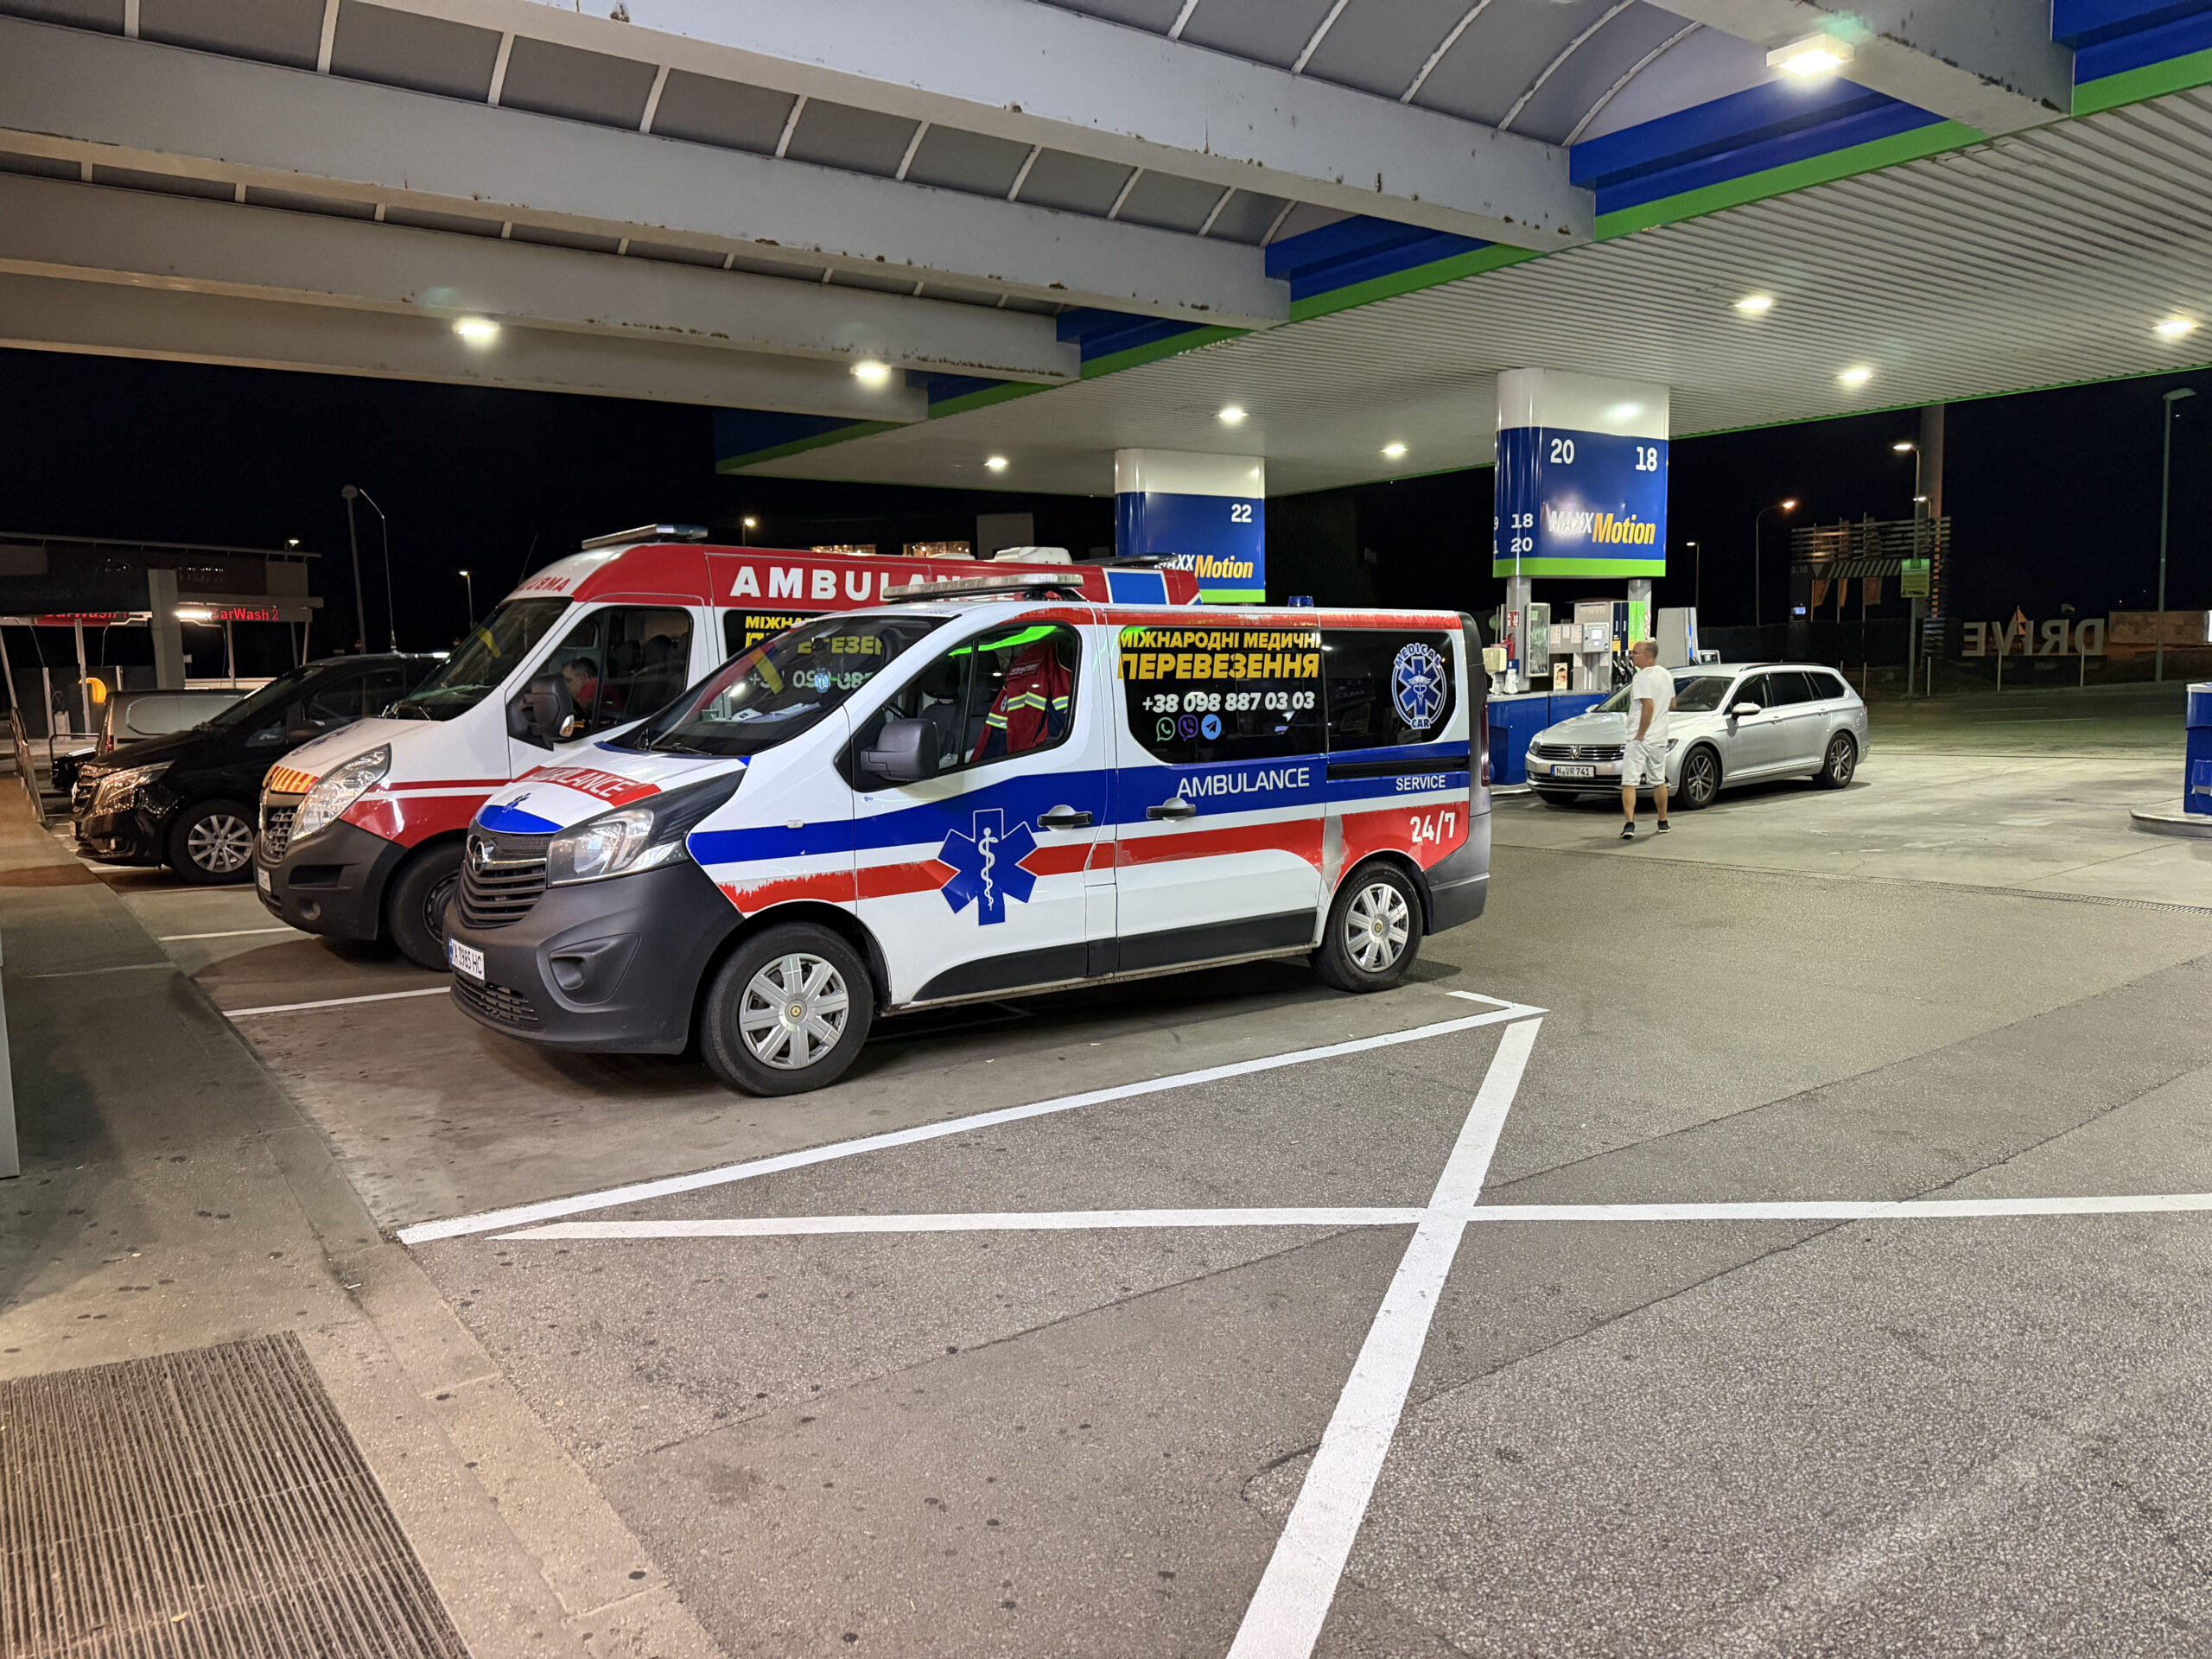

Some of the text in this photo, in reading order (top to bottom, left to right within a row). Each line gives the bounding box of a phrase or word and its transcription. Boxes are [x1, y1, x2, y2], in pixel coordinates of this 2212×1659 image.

[1550, 438, 1575, 465] 20
[1635, 446, 1658, 472] 18
[1231, 503, 1253, 523] 22
[1510, 513, 1534, 529] 18
[1510, 537, 1534, 553] 20
[271, 608, 279, 621] 2
[1118, 632, 1239, 651] МІЖНАРОДНІ
[1117, 653, 1320, 680] ПЕРЕВЕЗЕННЯ
[1394, 643, 1442, 669] MEDICAL
[1142, 694, 1179, 713] +38
[1183, 693, 1222, 712] 098
[1224, 693, 1262, 711] 887
[1264, 692, 1288, 710] 03
[1292, 691, 1315, 709] 03
[1410, 719, 1431, 728] CAR
[1176, 767, 1310, 798] AMBULANCE
[1395, 775, 1446, 791] SERVICE
[1410, 810, 1457, 845] 24/7
